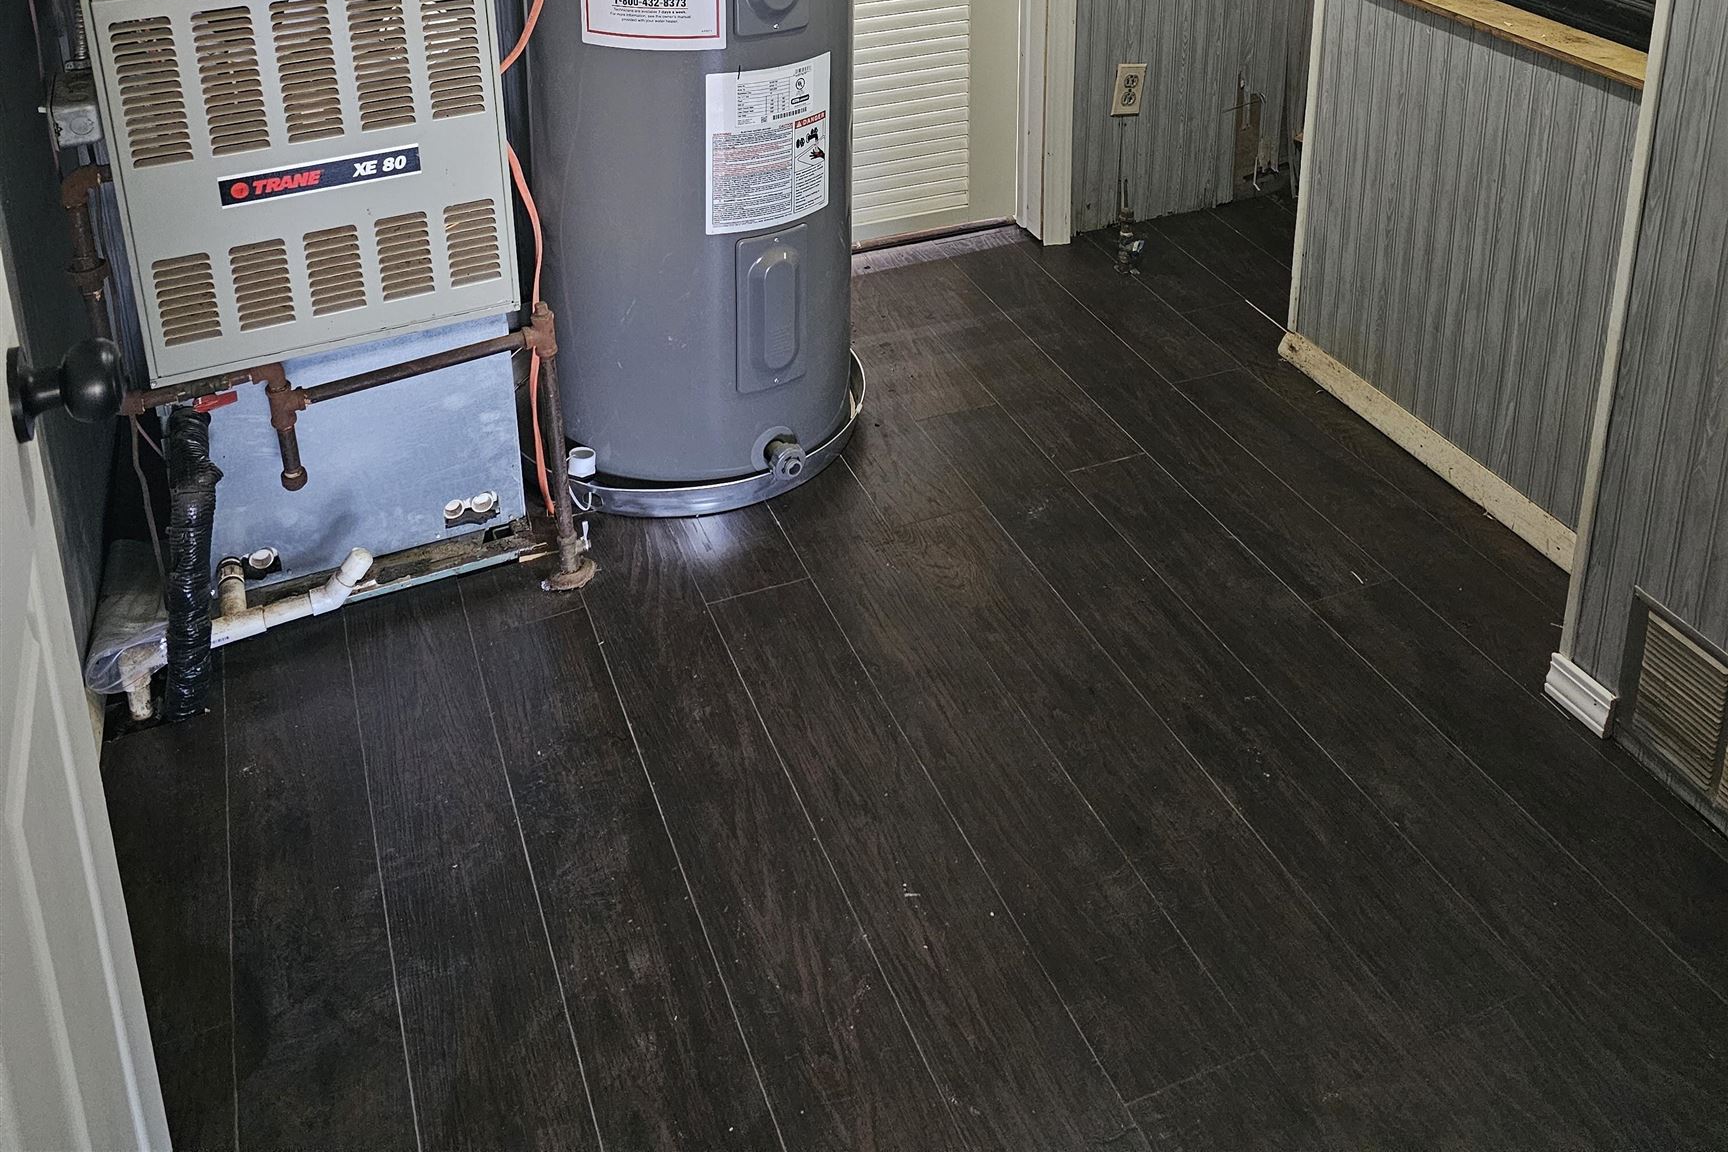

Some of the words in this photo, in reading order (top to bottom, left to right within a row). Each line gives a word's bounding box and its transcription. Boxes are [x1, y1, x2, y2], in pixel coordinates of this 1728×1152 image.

[803, 112, 825, 125] DANGER
[252, 170, 321, 195] TRANE
[353, 160, 377, 178] XE
[382, 156, 407, 172] 80
